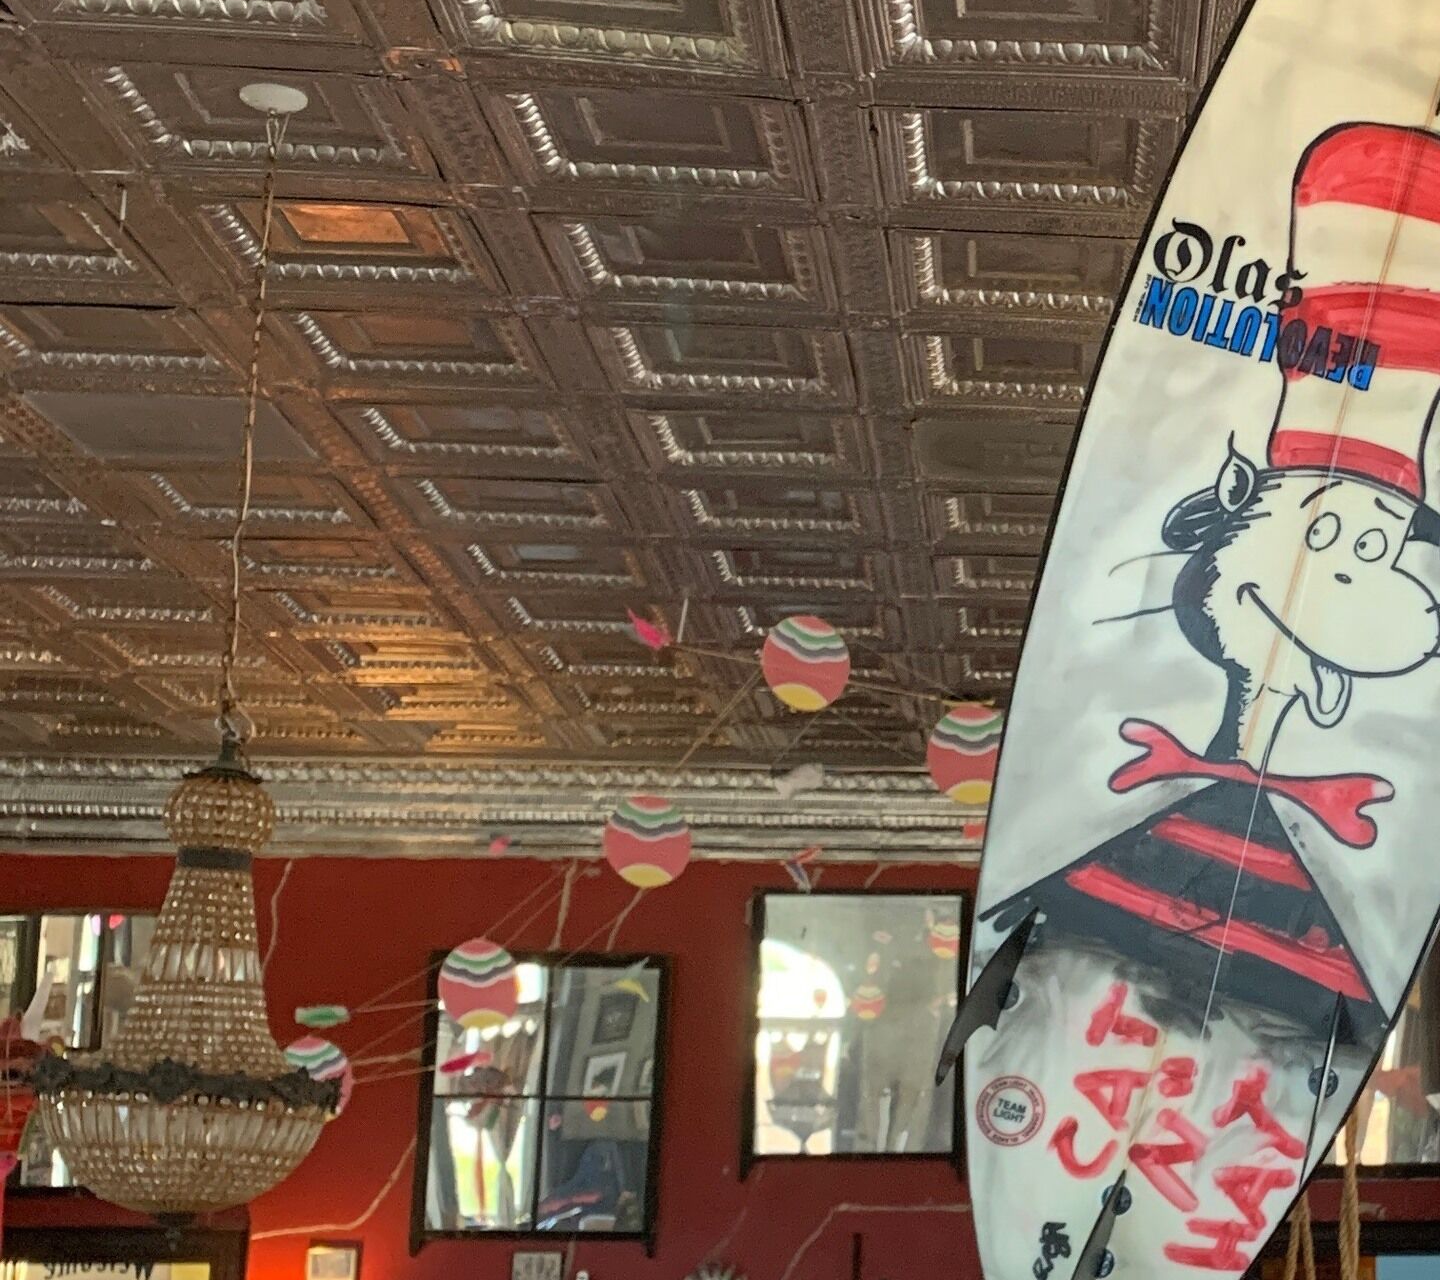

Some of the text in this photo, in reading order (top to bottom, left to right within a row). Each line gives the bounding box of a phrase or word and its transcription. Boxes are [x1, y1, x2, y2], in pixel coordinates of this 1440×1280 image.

[1153, 217, 1309, 310] Olas
[1138, 276, 1381, 392] REVOLUTION
[992, 1107, 1026, 1124] LIGHT
[998, 1097, 1027, 1114] TEAM
[1048, 981, 1159, 1180] CAT
[1164, 1064, 1306, 1272] HAT
